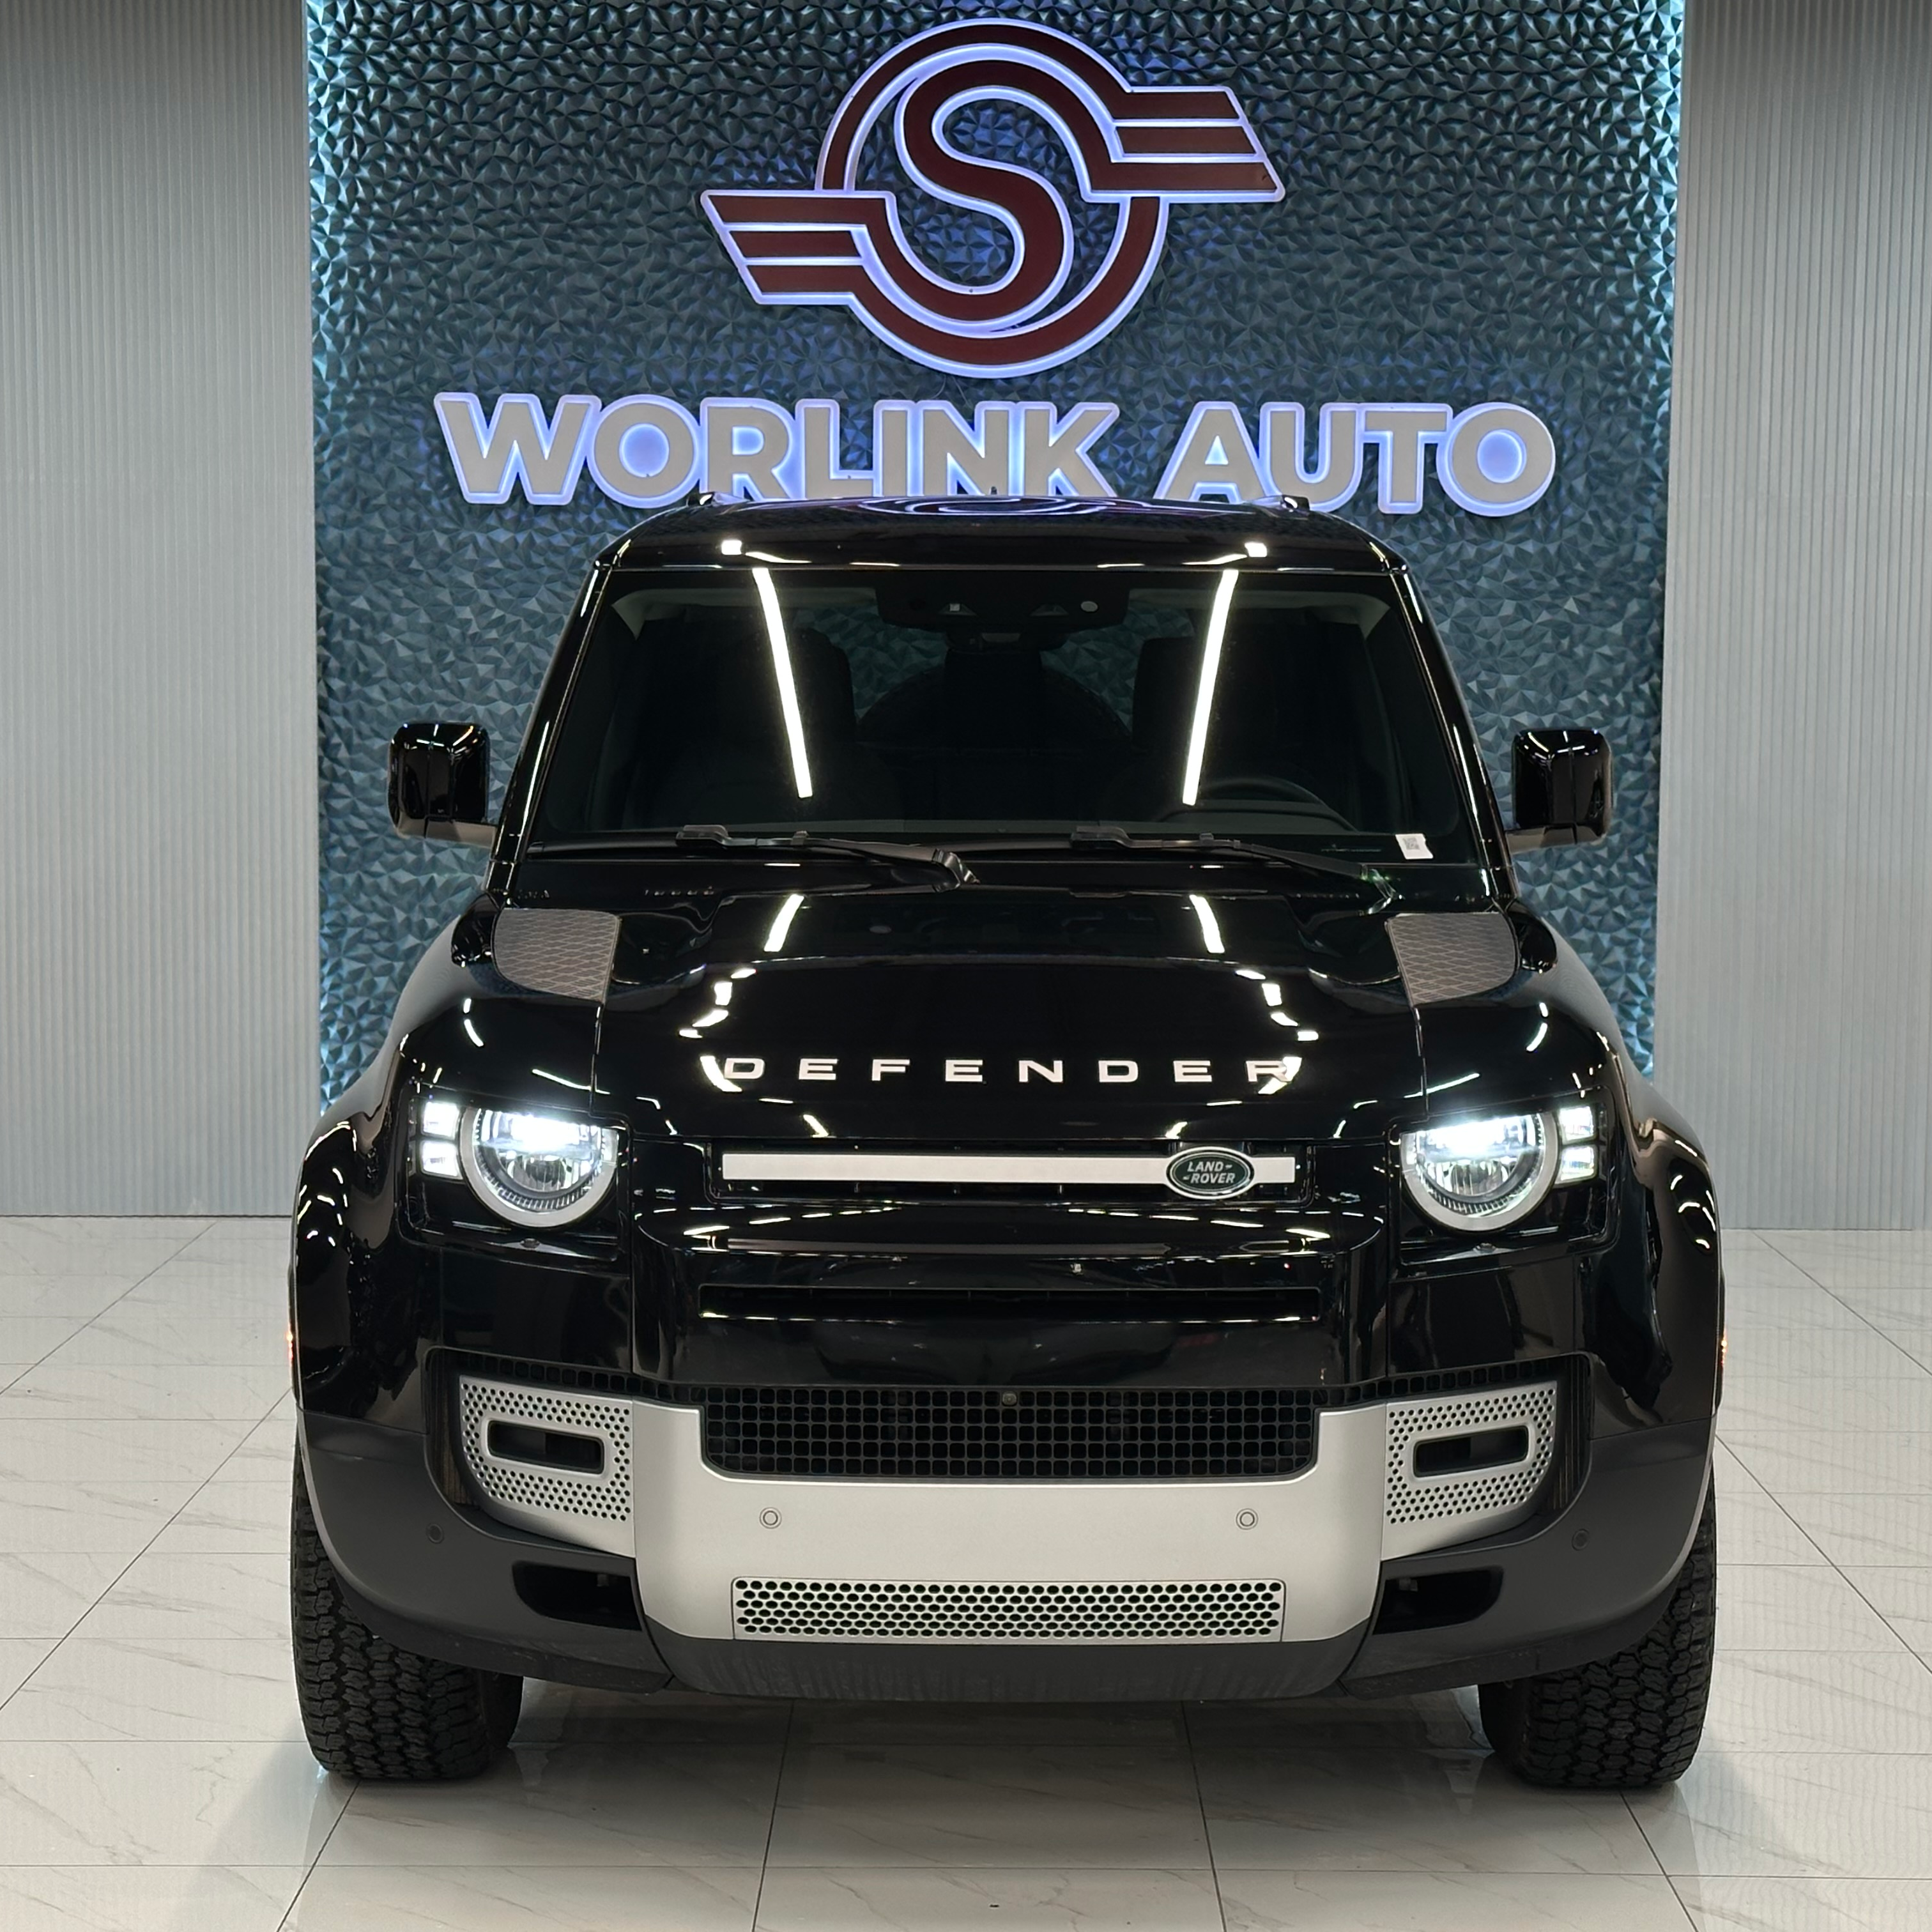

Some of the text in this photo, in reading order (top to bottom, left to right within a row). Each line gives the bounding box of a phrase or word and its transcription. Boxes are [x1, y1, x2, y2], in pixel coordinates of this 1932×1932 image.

[436, 392, 1556, 516] WORLINK AUTO
[724, 1057, 1290, 1082] DEFENDER
[1186, 1161, 1225, 1172] LAND
[1190, 1172, 1236, 1184] ROVER
